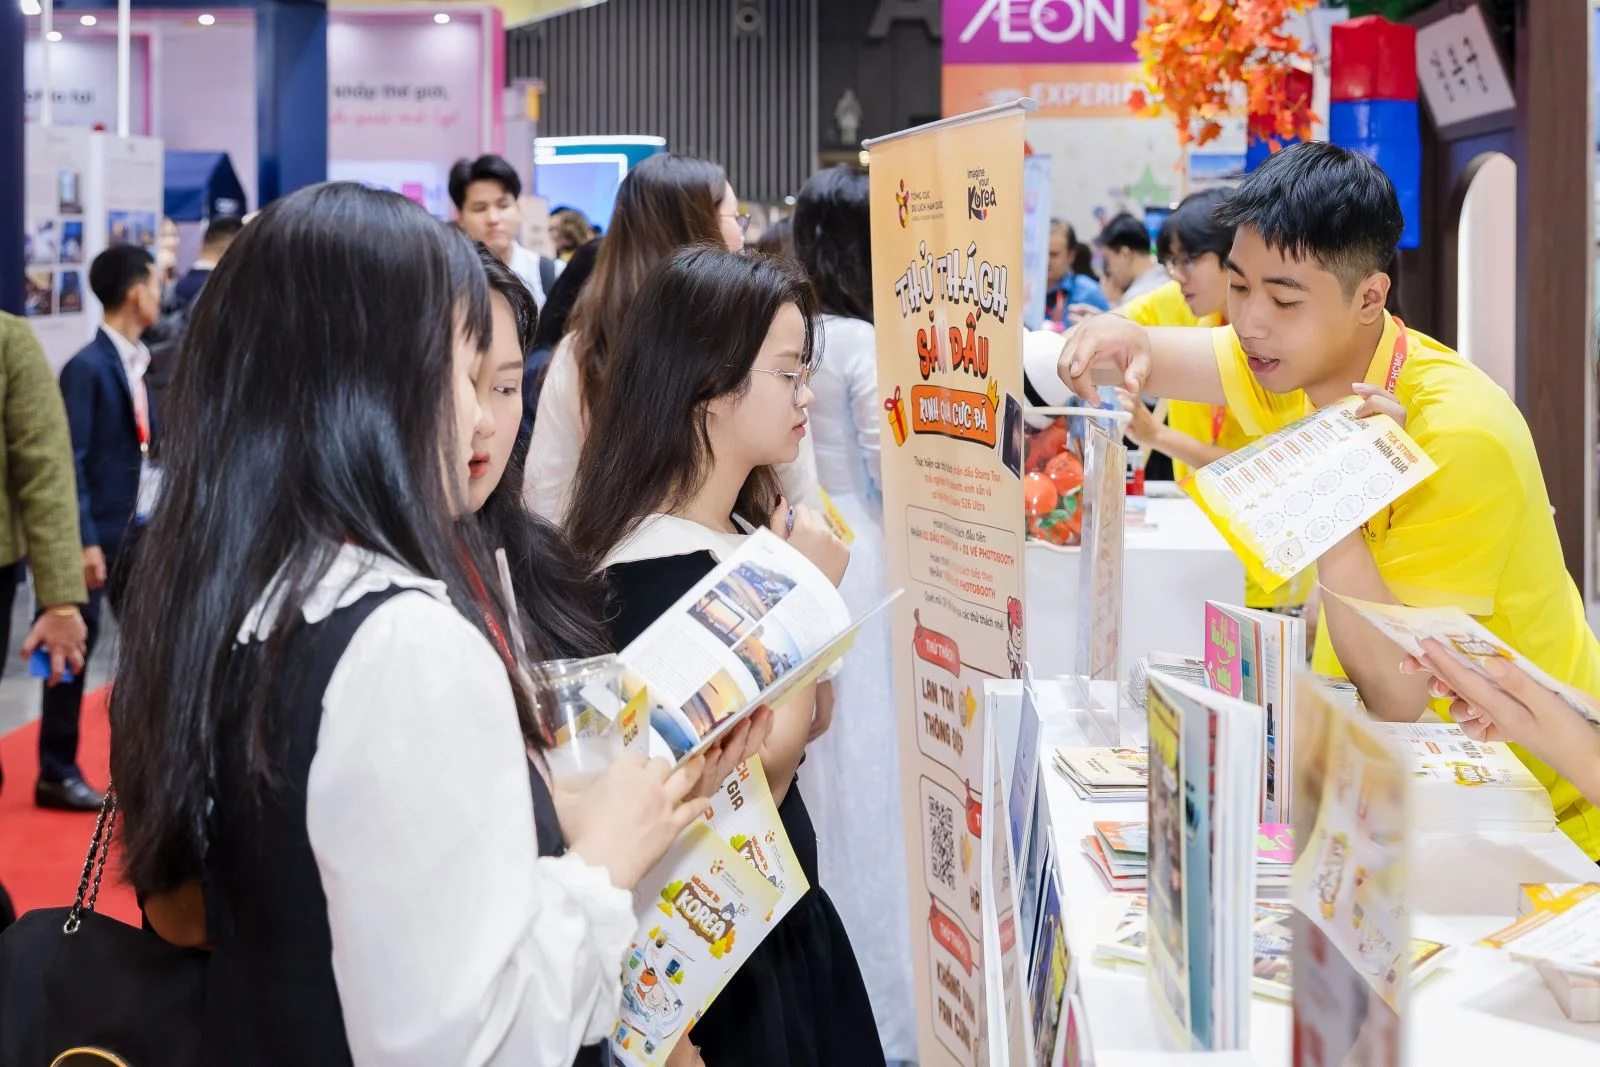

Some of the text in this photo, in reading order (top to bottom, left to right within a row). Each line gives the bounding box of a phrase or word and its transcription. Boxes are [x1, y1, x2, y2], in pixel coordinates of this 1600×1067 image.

[967, 185, 997, 220] Korea
[895, 240, 1008, 324] THỬ THÁCH
[948, 307, 989, 380] DẤU
[1390, 351, 1404, 380] HCMC
[920, 396, 939, 423] RINH
[952, 400, 972, 436] CỰC
[1385, 430, 1419, 465] TICK STAMP
[979, 547, 1015, 567] PHOTOBOOTH
[922, 677, 938, 705] LAN
[727, 779, 744, 812] GIA
[677, 889, 727, 941] KOREA
